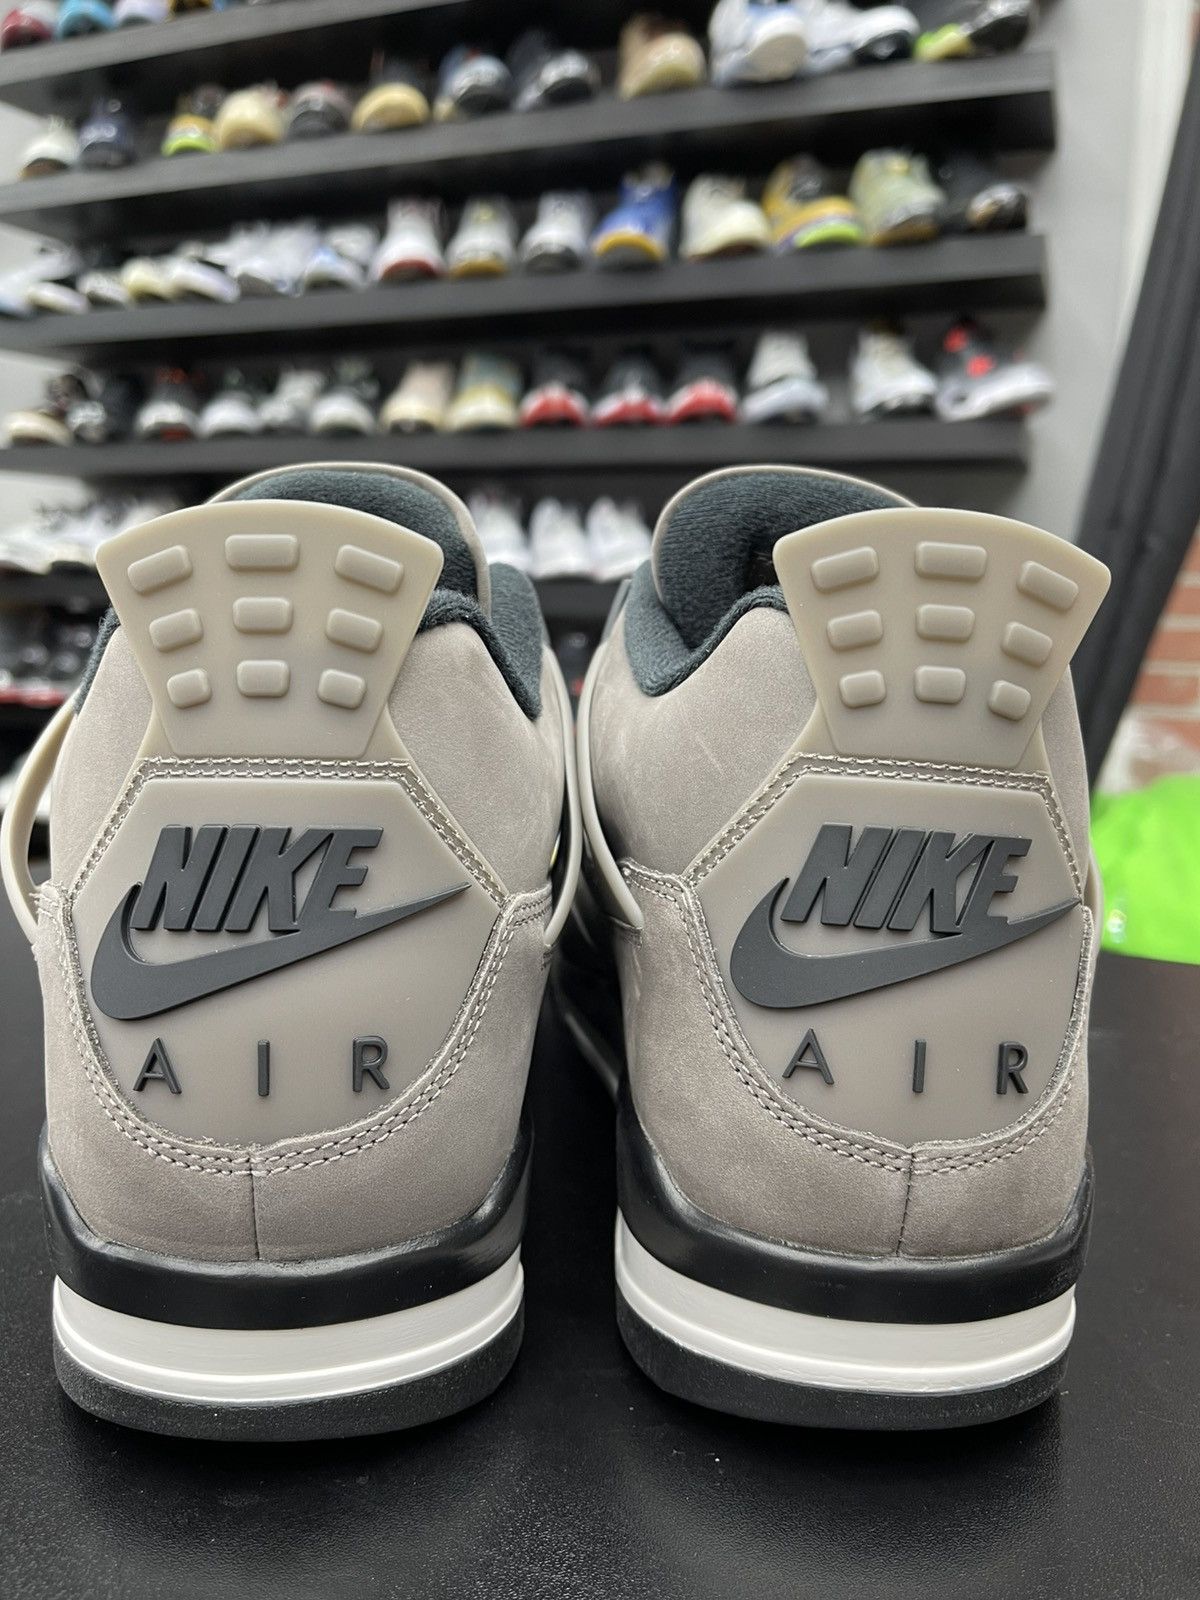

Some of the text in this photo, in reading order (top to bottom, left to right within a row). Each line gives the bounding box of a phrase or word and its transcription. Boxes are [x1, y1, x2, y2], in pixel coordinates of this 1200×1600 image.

[130, 824, 384, 934] NIKE
[780, 823, 1033, 934] NIKE
[132, 1034, 390, 1097] AIR
[782, 1028, 1030, 1095] AIR
